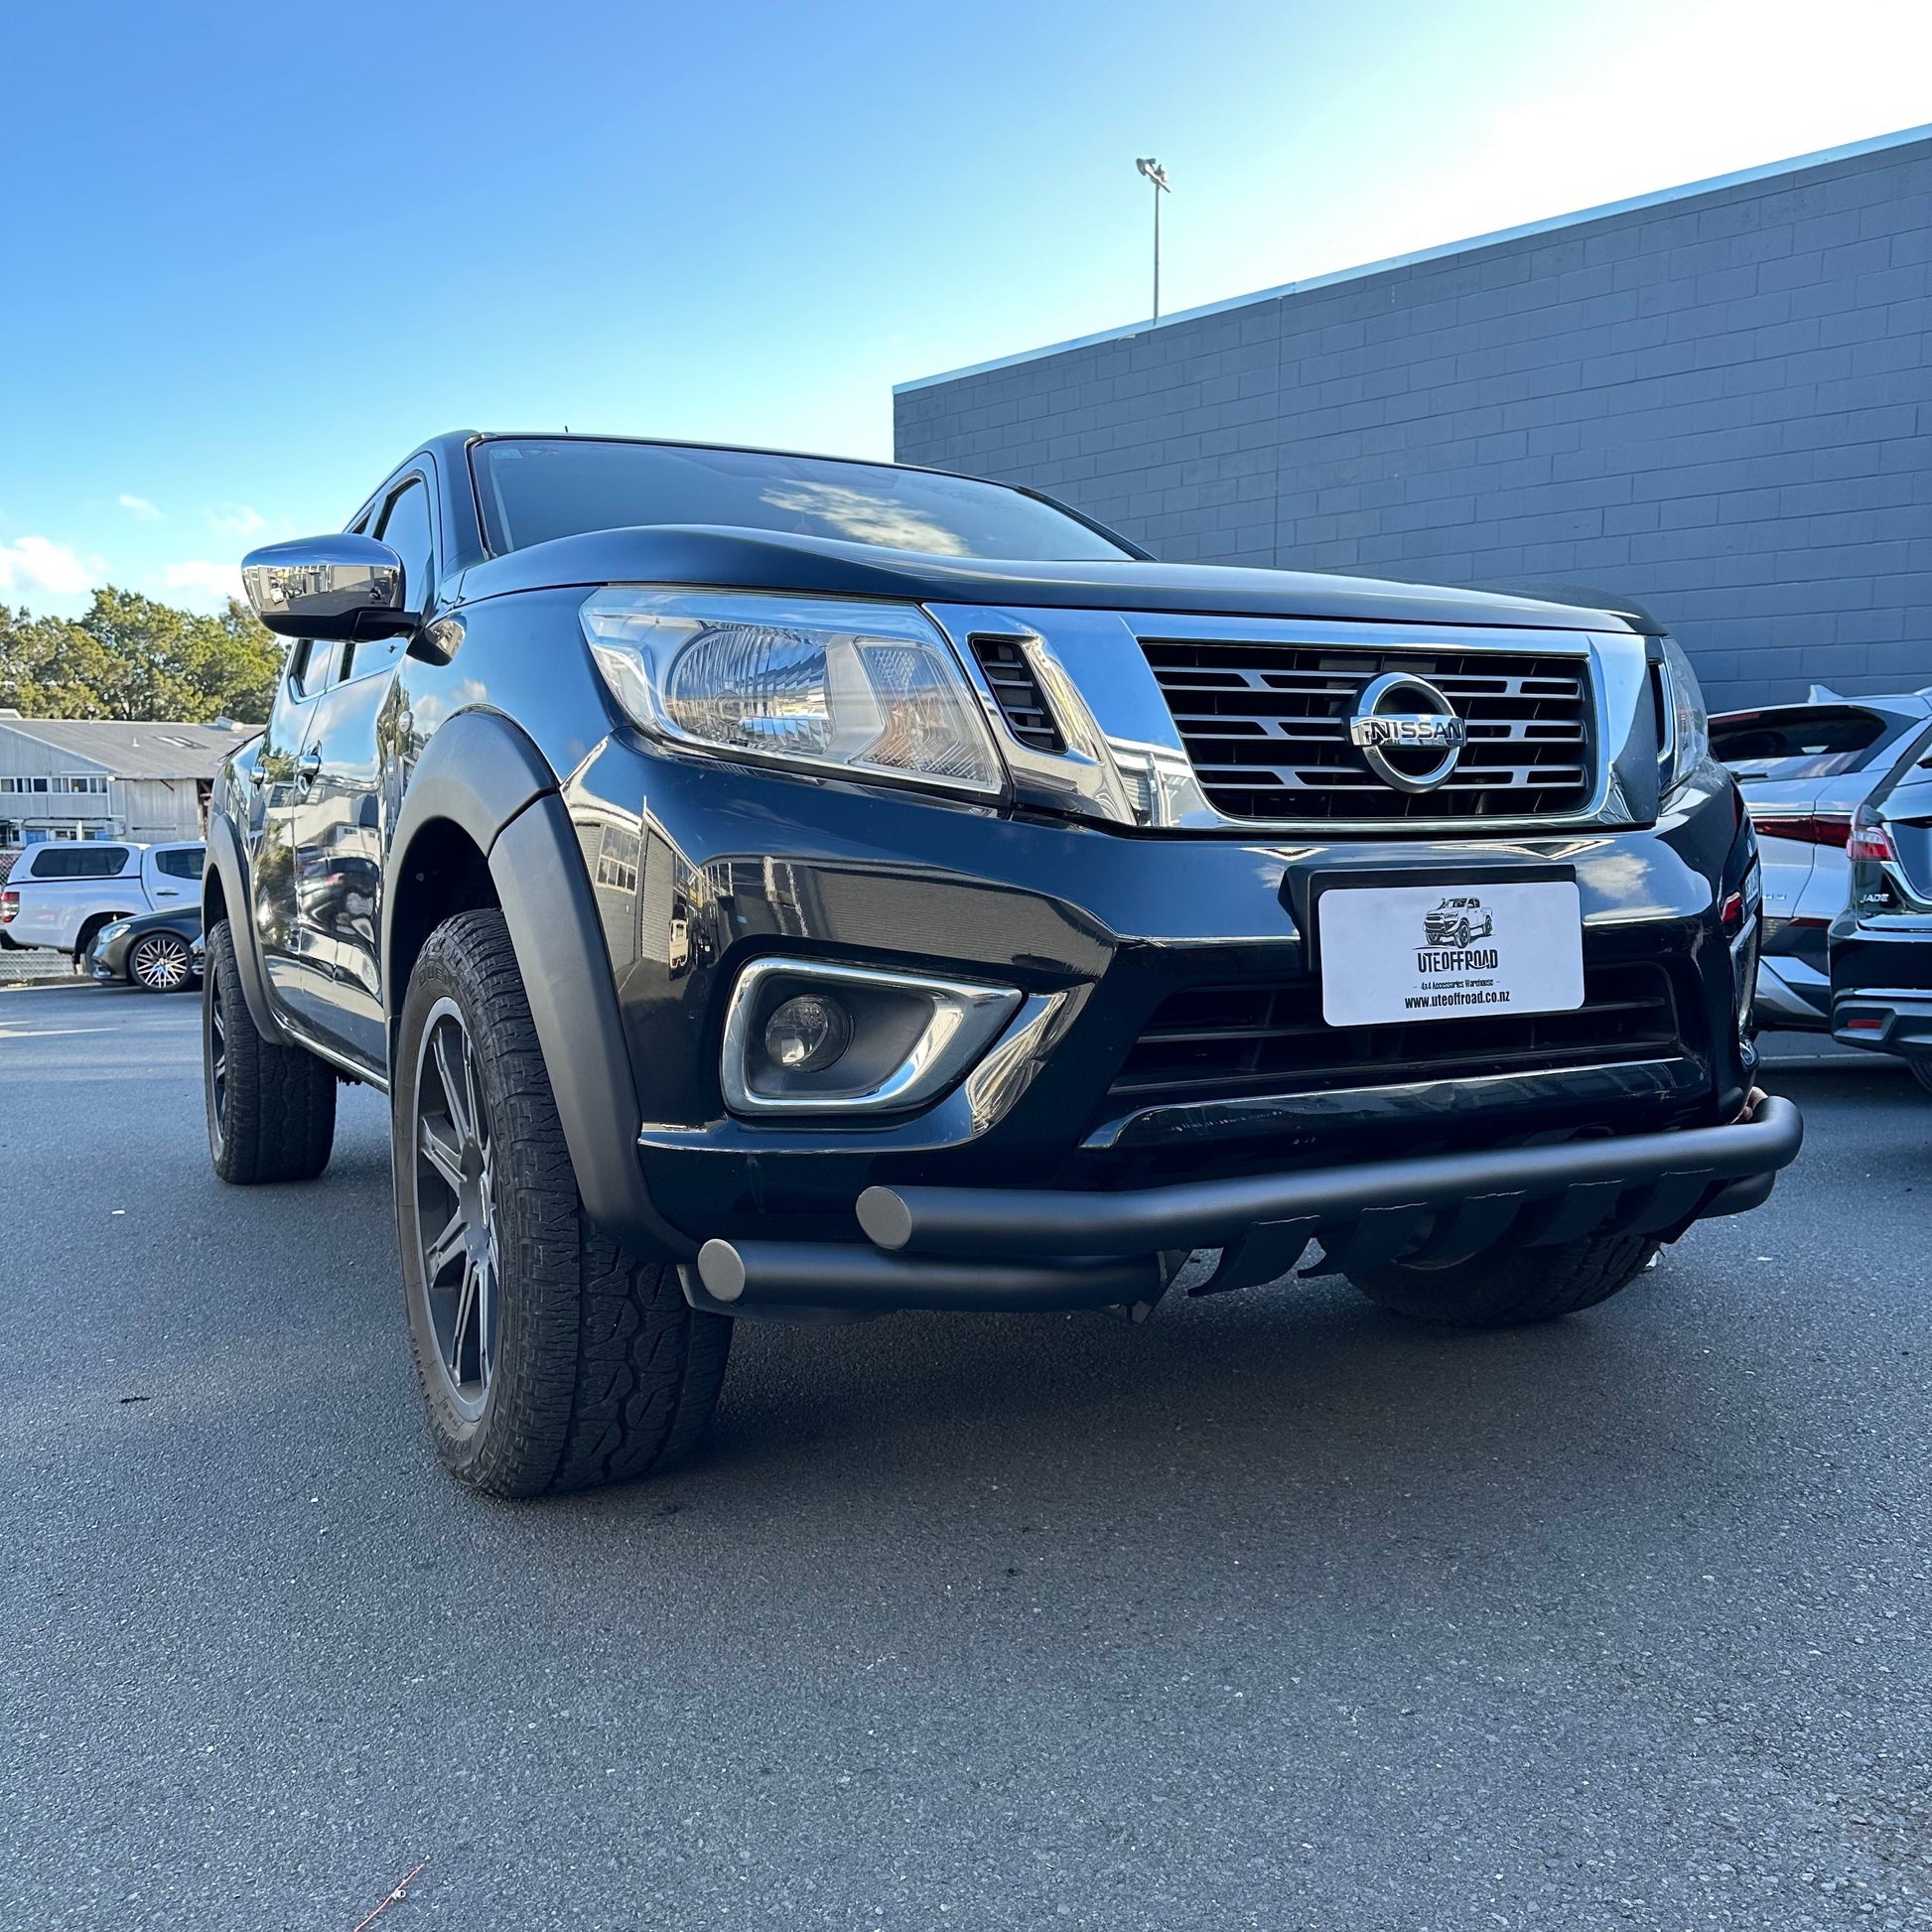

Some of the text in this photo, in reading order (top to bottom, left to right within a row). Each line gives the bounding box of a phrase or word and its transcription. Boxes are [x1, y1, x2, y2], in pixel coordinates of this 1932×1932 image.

[1370, 721, 1462, 741] NISSAN
[1860, 894, 1889, 903] JADE
[1433, 980, 1464, 990] Accessories
[1465, 979, 1493, 988] Warehouse
[1404, 991, 1510, 1009] www.uteoffroad.co.nz
